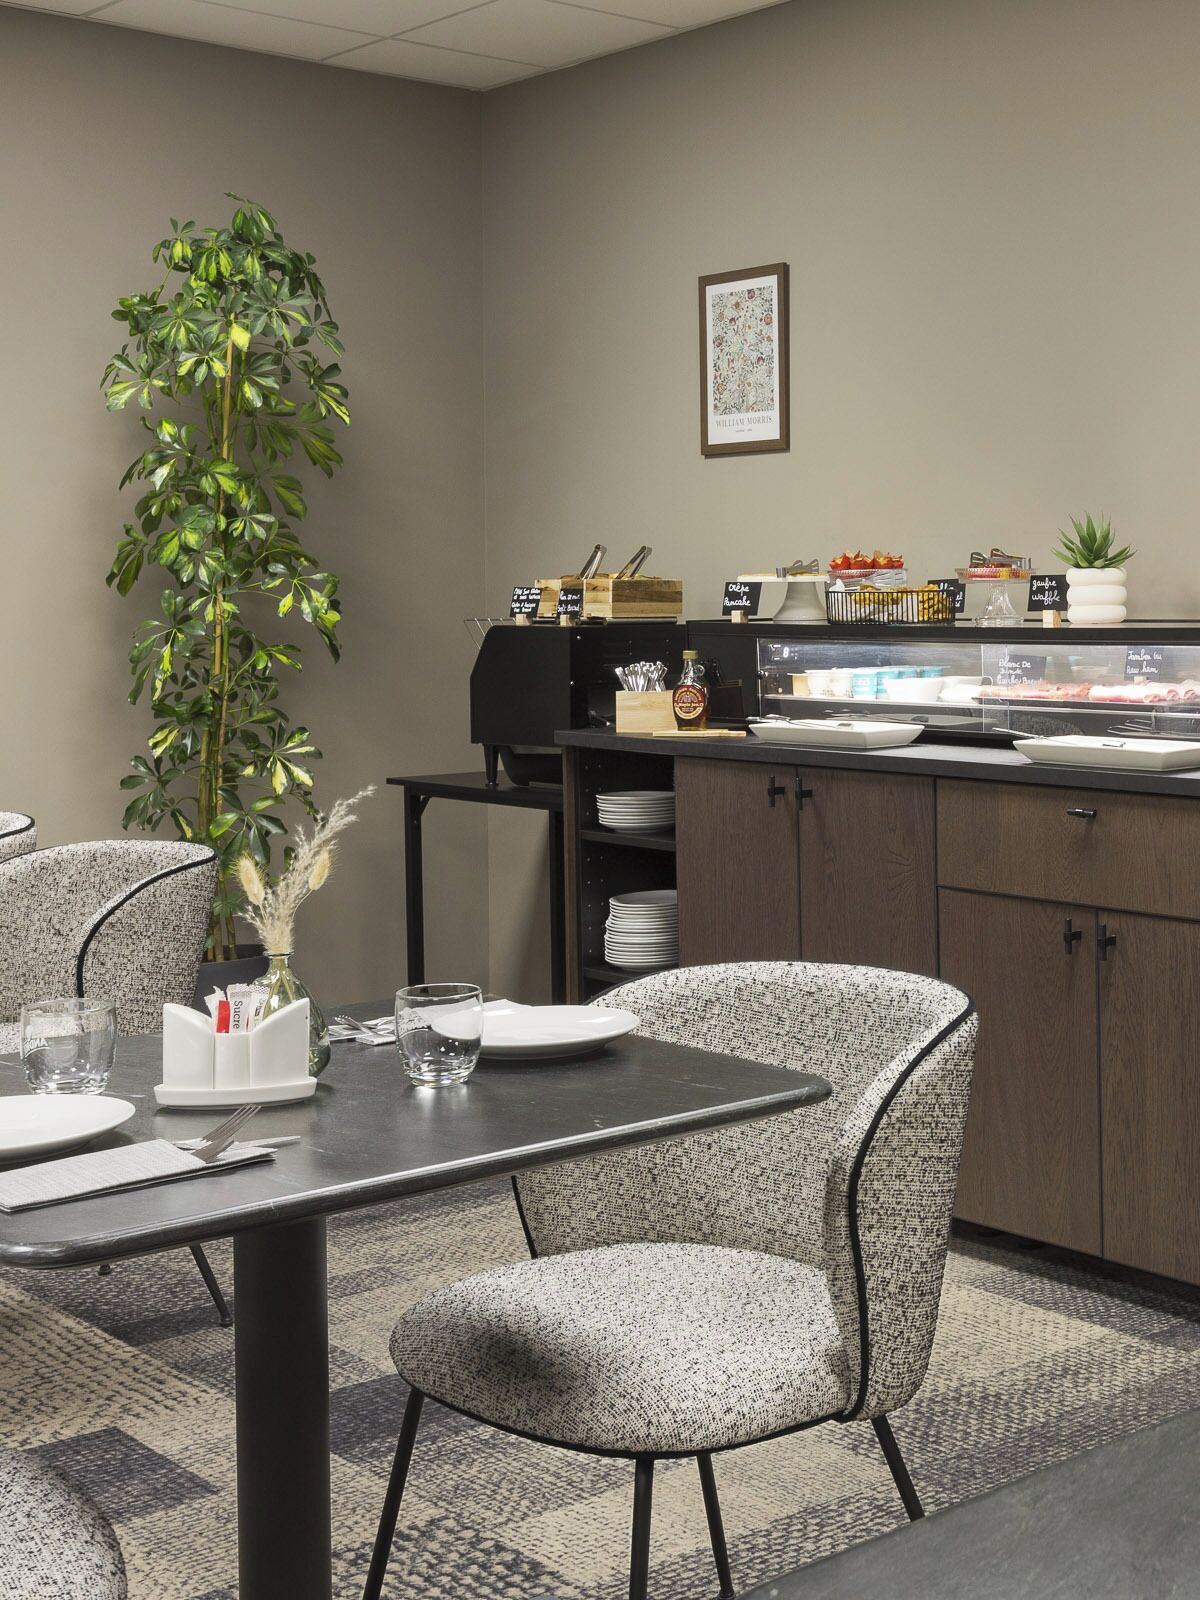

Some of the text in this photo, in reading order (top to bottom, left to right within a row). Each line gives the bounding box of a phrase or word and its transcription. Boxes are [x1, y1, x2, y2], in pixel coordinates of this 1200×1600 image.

[716, 416, 772, 428] WILLIAM MORRIS
[233, 1000, 243, 1029] Sucre
